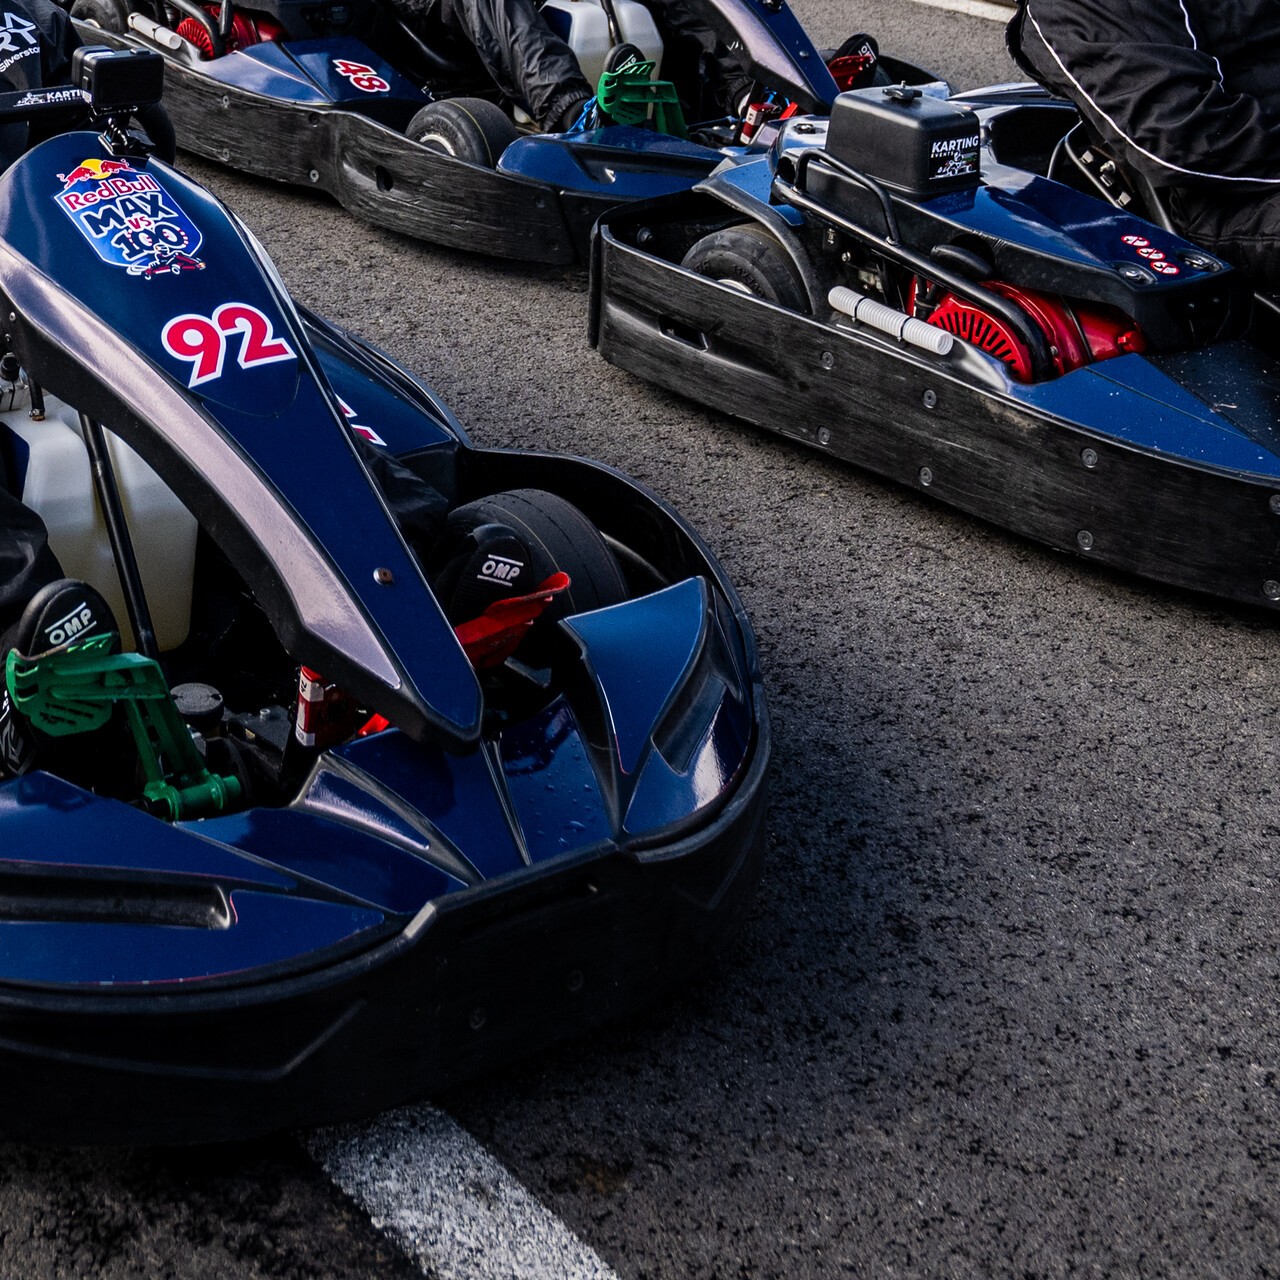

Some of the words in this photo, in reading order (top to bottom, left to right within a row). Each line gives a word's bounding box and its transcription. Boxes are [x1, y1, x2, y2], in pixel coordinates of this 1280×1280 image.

[332, 59, 391, 93] 48
[46, 89, 84, 100] KARTI
[930, 151, 955, 159] EVENTS
[931, 135, 979, 153] KARTING
[64, 181, 116, 211] Red
[110, 175, 160, 194] Bull
[81, 193, 178, 238] MAX
[111, 222, 189, 261] 100
[161, 301, 297, 388] 92
[481, 560, 521, 581] OMP
[49, 608, 92, 645] OMP
